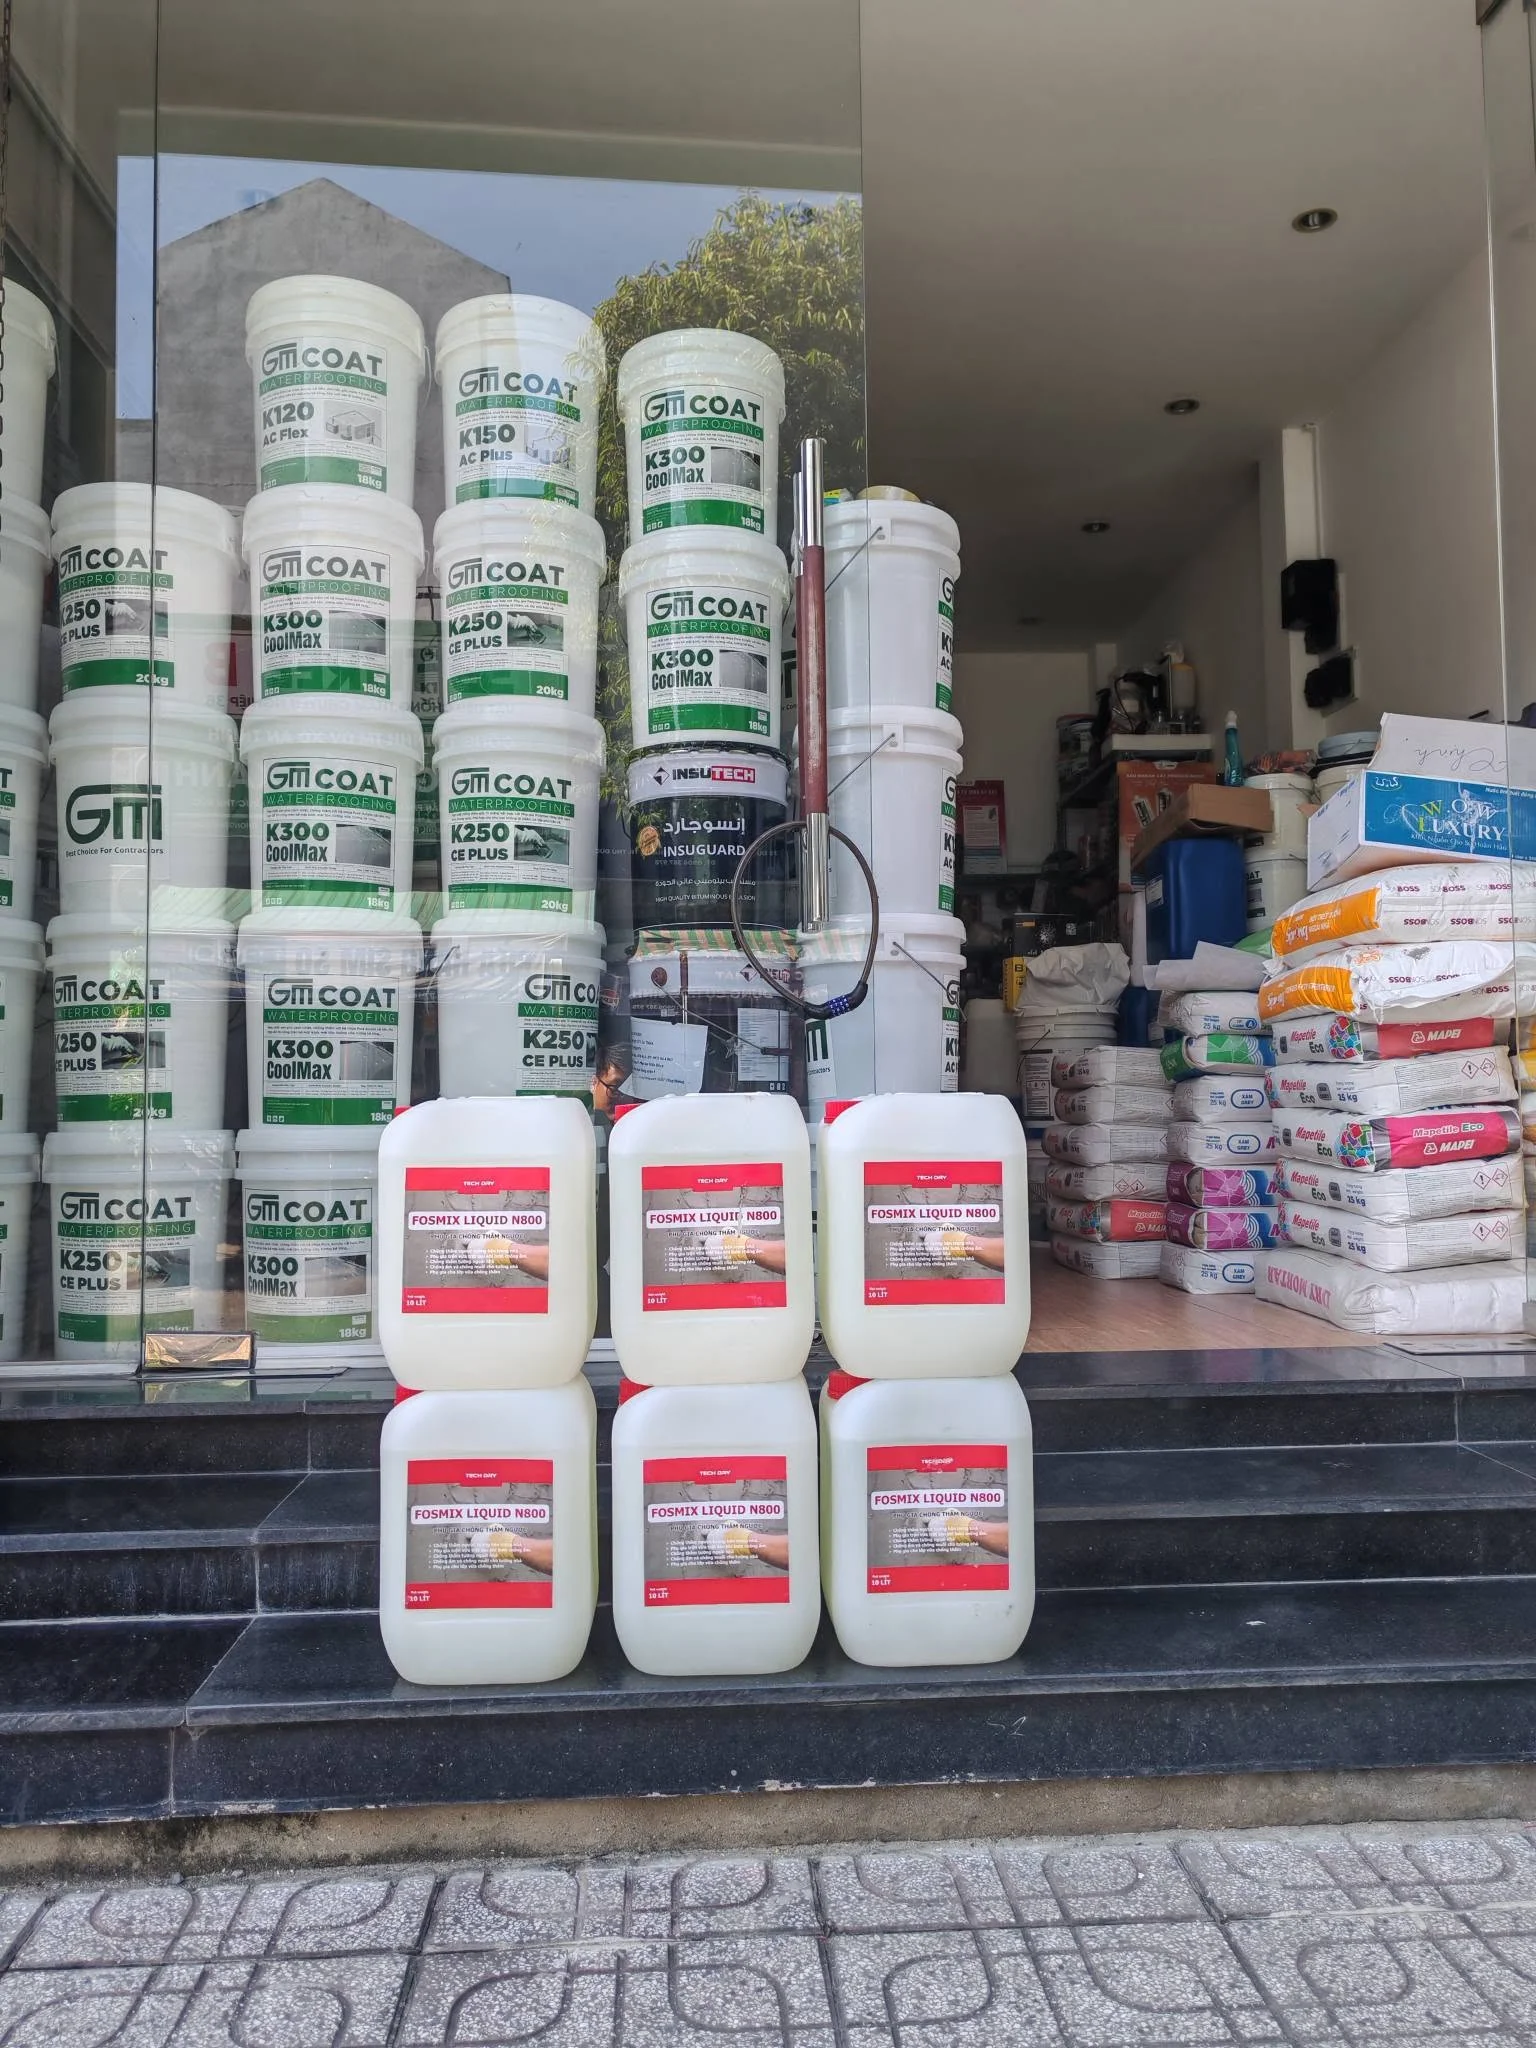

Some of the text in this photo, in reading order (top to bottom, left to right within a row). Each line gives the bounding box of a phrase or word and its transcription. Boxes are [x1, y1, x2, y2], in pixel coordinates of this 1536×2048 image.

[302, 348, 383, 376] COAT
[504, 372, 577, 401] COAT
[263, 401, 314, 430] K120
[690, 395, 760, 422] COAT
[263, 428, 308, 448] AC Flex
[459, 424, 515, 449] K150
[459, 449, 512, 466] AC Plus
[645, 446, 705, 472] K300
[358, 474, 382, 489] 18kg
[646, 467, 704, 492] CoolMax
[742, 517, 761, 531] 18kg
[85, 549, 168, 570] COAT
[307, 556, 386, 583] COAT
[486, 562, 564, 585] COAT
[698, 596, 768, 623] COAT
[264, 610, 322, 633] K300
[449, 611, 501, 637] K250
[69, 625, 100, 641] PLUS
[264, 632, 322, 653] CoolMax
[449, 635, 502, 654] CE PLUS
[652, 649, 713, 671] K300
[652, 670, 712, 690] CoolMax
[363, 682, 386, 697] 18kg
[537, 685, 564, 699] 20kg
[749, 721, 768, 735] 18kg
[315, 769, 393, 795] COAT
[673, 767, 755, 782] INSUTECH
[495, 773, 571, 798] COAT
[264, 794, 393, 811] WATERPROOFING
[450, 800, 572, 815] WATERPROOFING
[266, 822, 329, 842] K300
[451, 823, 510, 844] K250
[1419, 817, 1505, 841] LUXURY
[266, 844, 327, 863] CoolMax
[451, 848, 508, 862] CE PLUS
[664, 844, 745, 857] INSUGUARD
[367, 896, 390, 910] 18kg
[542, 900, 569, 913] 20kg
[81, 979, 165, 1001] COAT
[319, 985, 396, 1008] COAT
[267, 1011, 396, 1024] WATERPROOFING
[524, 1030, 584, 1050] K250
[1427, 1028, 1461, 1041] MAPEI
[268, 1040, 333, 1059] K300
[1309, 1042, 1324, 1053] Eco
[64, 1058, 96, 1071] PLUS
[522, 1055, 583, 1067] CE PLUS
[268, 1061, 332, 1082] CoolMax
[1281, 1080, 1307, 1093] Mapetile
[1300, 1092, 1315, 1103] Eco
[1347, 1094, 1357, 1102] kg
[371, 1112, 393, 1124] 18kg
[1296, 1127, 1326, 1142] Mapetile
[1414, 1122, 1484, 1137] Mapetile Eco
[1317, 1143, 1332, 1156] Eco
[1439, 1139, 1474, 1153] MAPEI
[1291, 1171, 1319, 1187] Mapetile
[1312, 1188, 1326, 1201] Eco
[1356, 1196, 1366, 1206] kg
[104, 1197, 191, 1220] COAT
[284, 1199, 367, 1222] COAT
[872, 1208, 996, 1220] FOSMIX LIQUID N800
[412, 1215, 542, 1227] FOSMIX LIQUID N800
[650, 1213, 696, 1224] FOSMIX
[747, 1211, 777, 1221] N800
[1292, 1214, 1319, 1231] Mapetile
[60, 1223, 191, 1236] WATERPROOFING
[1311, 1232, 1325, 1246] Eco
[1356, 1243, 1366, 1254] kg
[60, 1250, 123, 1272] K250
[248, 1256, 298, 1277] K300
[1210, 1271, 1217, 1279] kg
[60, 1276, 121, 1291] CE PLUS
[248, 1276, 297, 1298] CoolMax
[1267, 1265, 1331, 1310] DRY MORTAR
[340, 1328, 366, 1339] 18kg
[875, 1493, 1001, 1505] FOSMIX LIQUID N800
[415, 1508, 546, 1520] FOSMIX LIQUID N800
[652, 1504, 780, 1518] FOSMIX LIQUID N800
